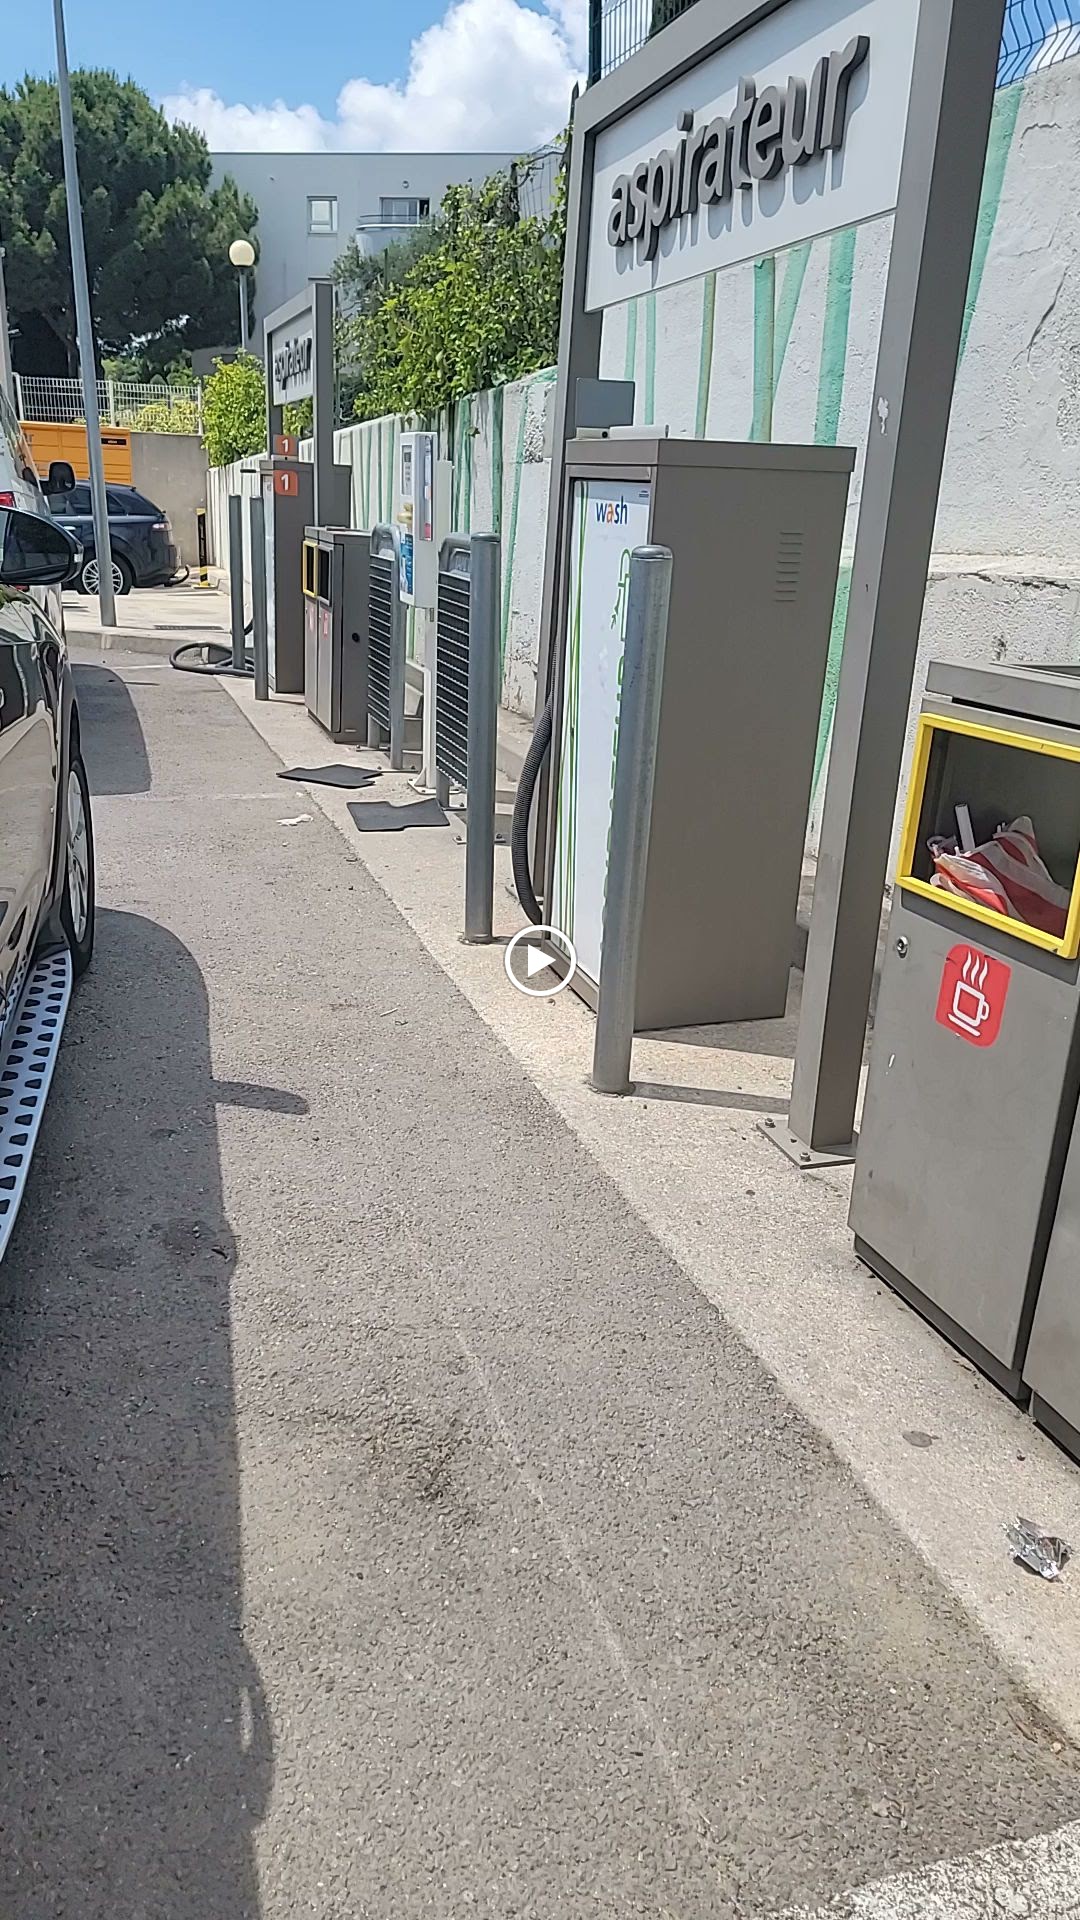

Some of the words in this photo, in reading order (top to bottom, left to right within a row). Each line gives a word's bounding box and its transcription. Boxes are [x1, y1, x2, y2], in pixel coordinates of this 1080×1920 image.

[608, 35, 870, 261] aspirateur
[282, 439, 289, 453] 1
[281, 473, 289, 491] 1
[596, 495, 628, 525] wash
